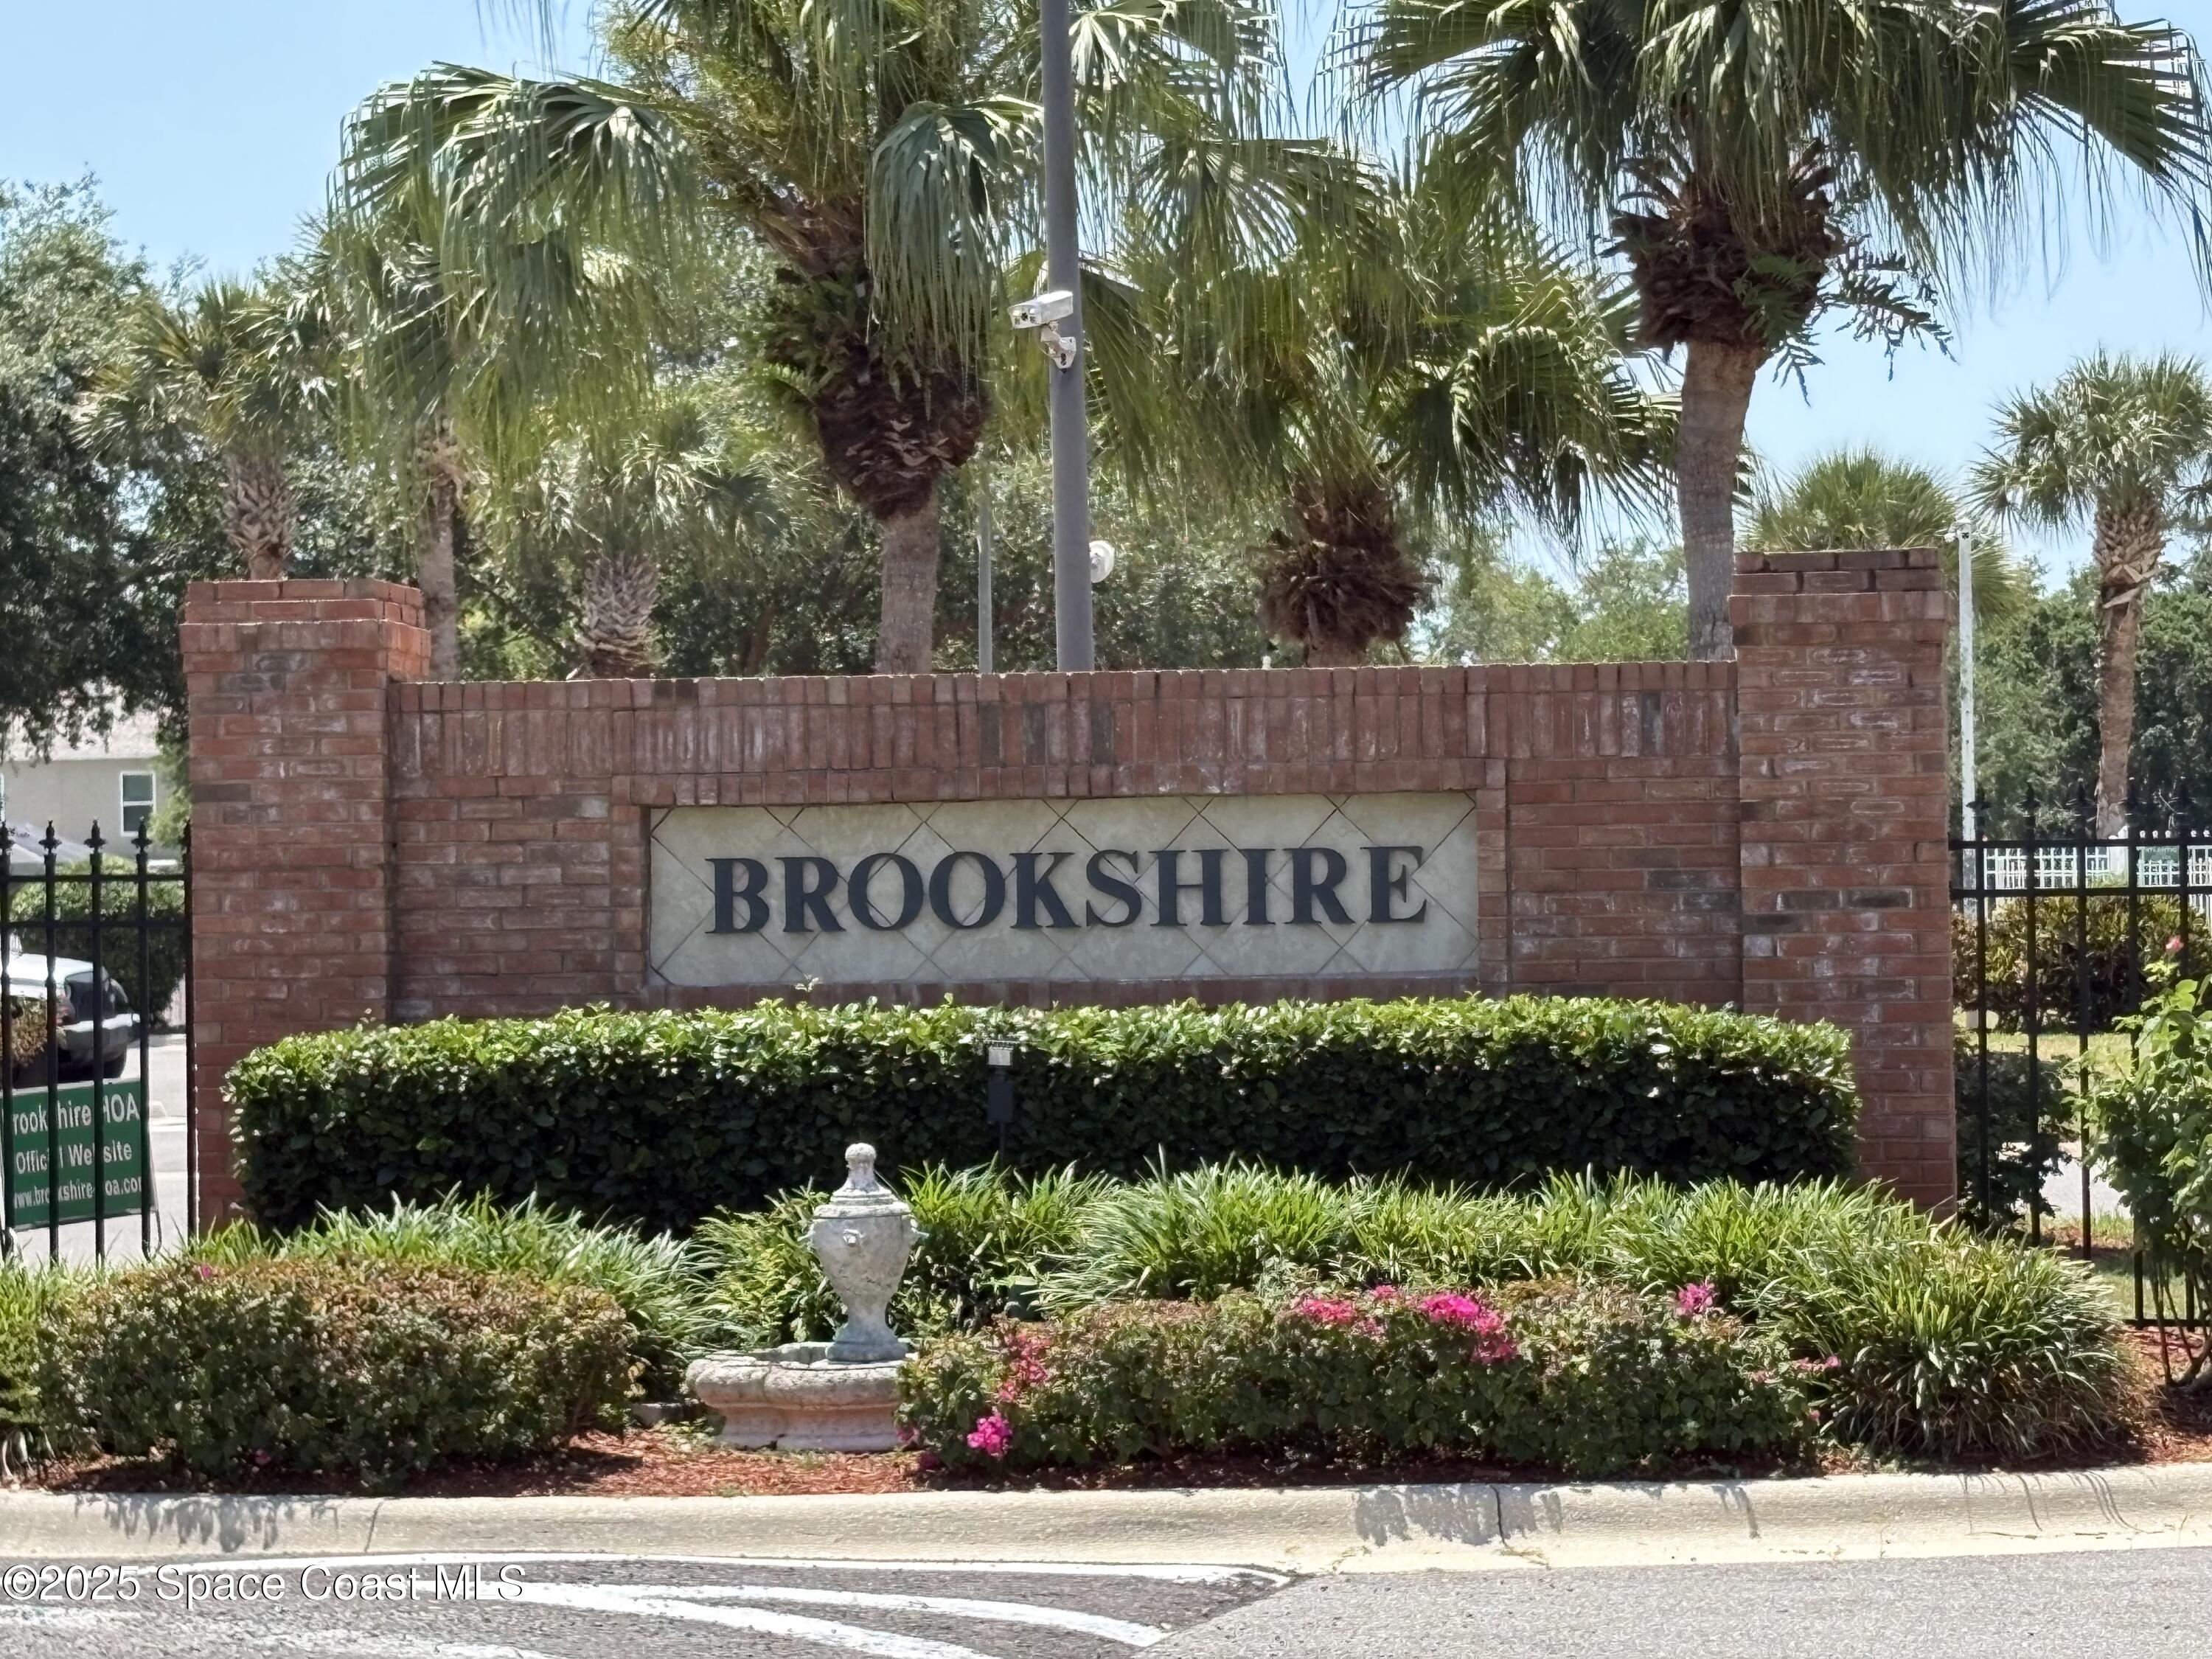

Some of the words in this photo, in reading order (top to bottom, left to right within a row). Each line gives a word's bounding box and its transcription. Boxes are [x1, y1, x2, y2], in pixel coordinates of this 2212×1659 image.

[704, 845, 1427, 934] BROOKSHIRE
[13, 1099, 92, 1136] rookhire
[15, 1144, 64, 1175] Officl
